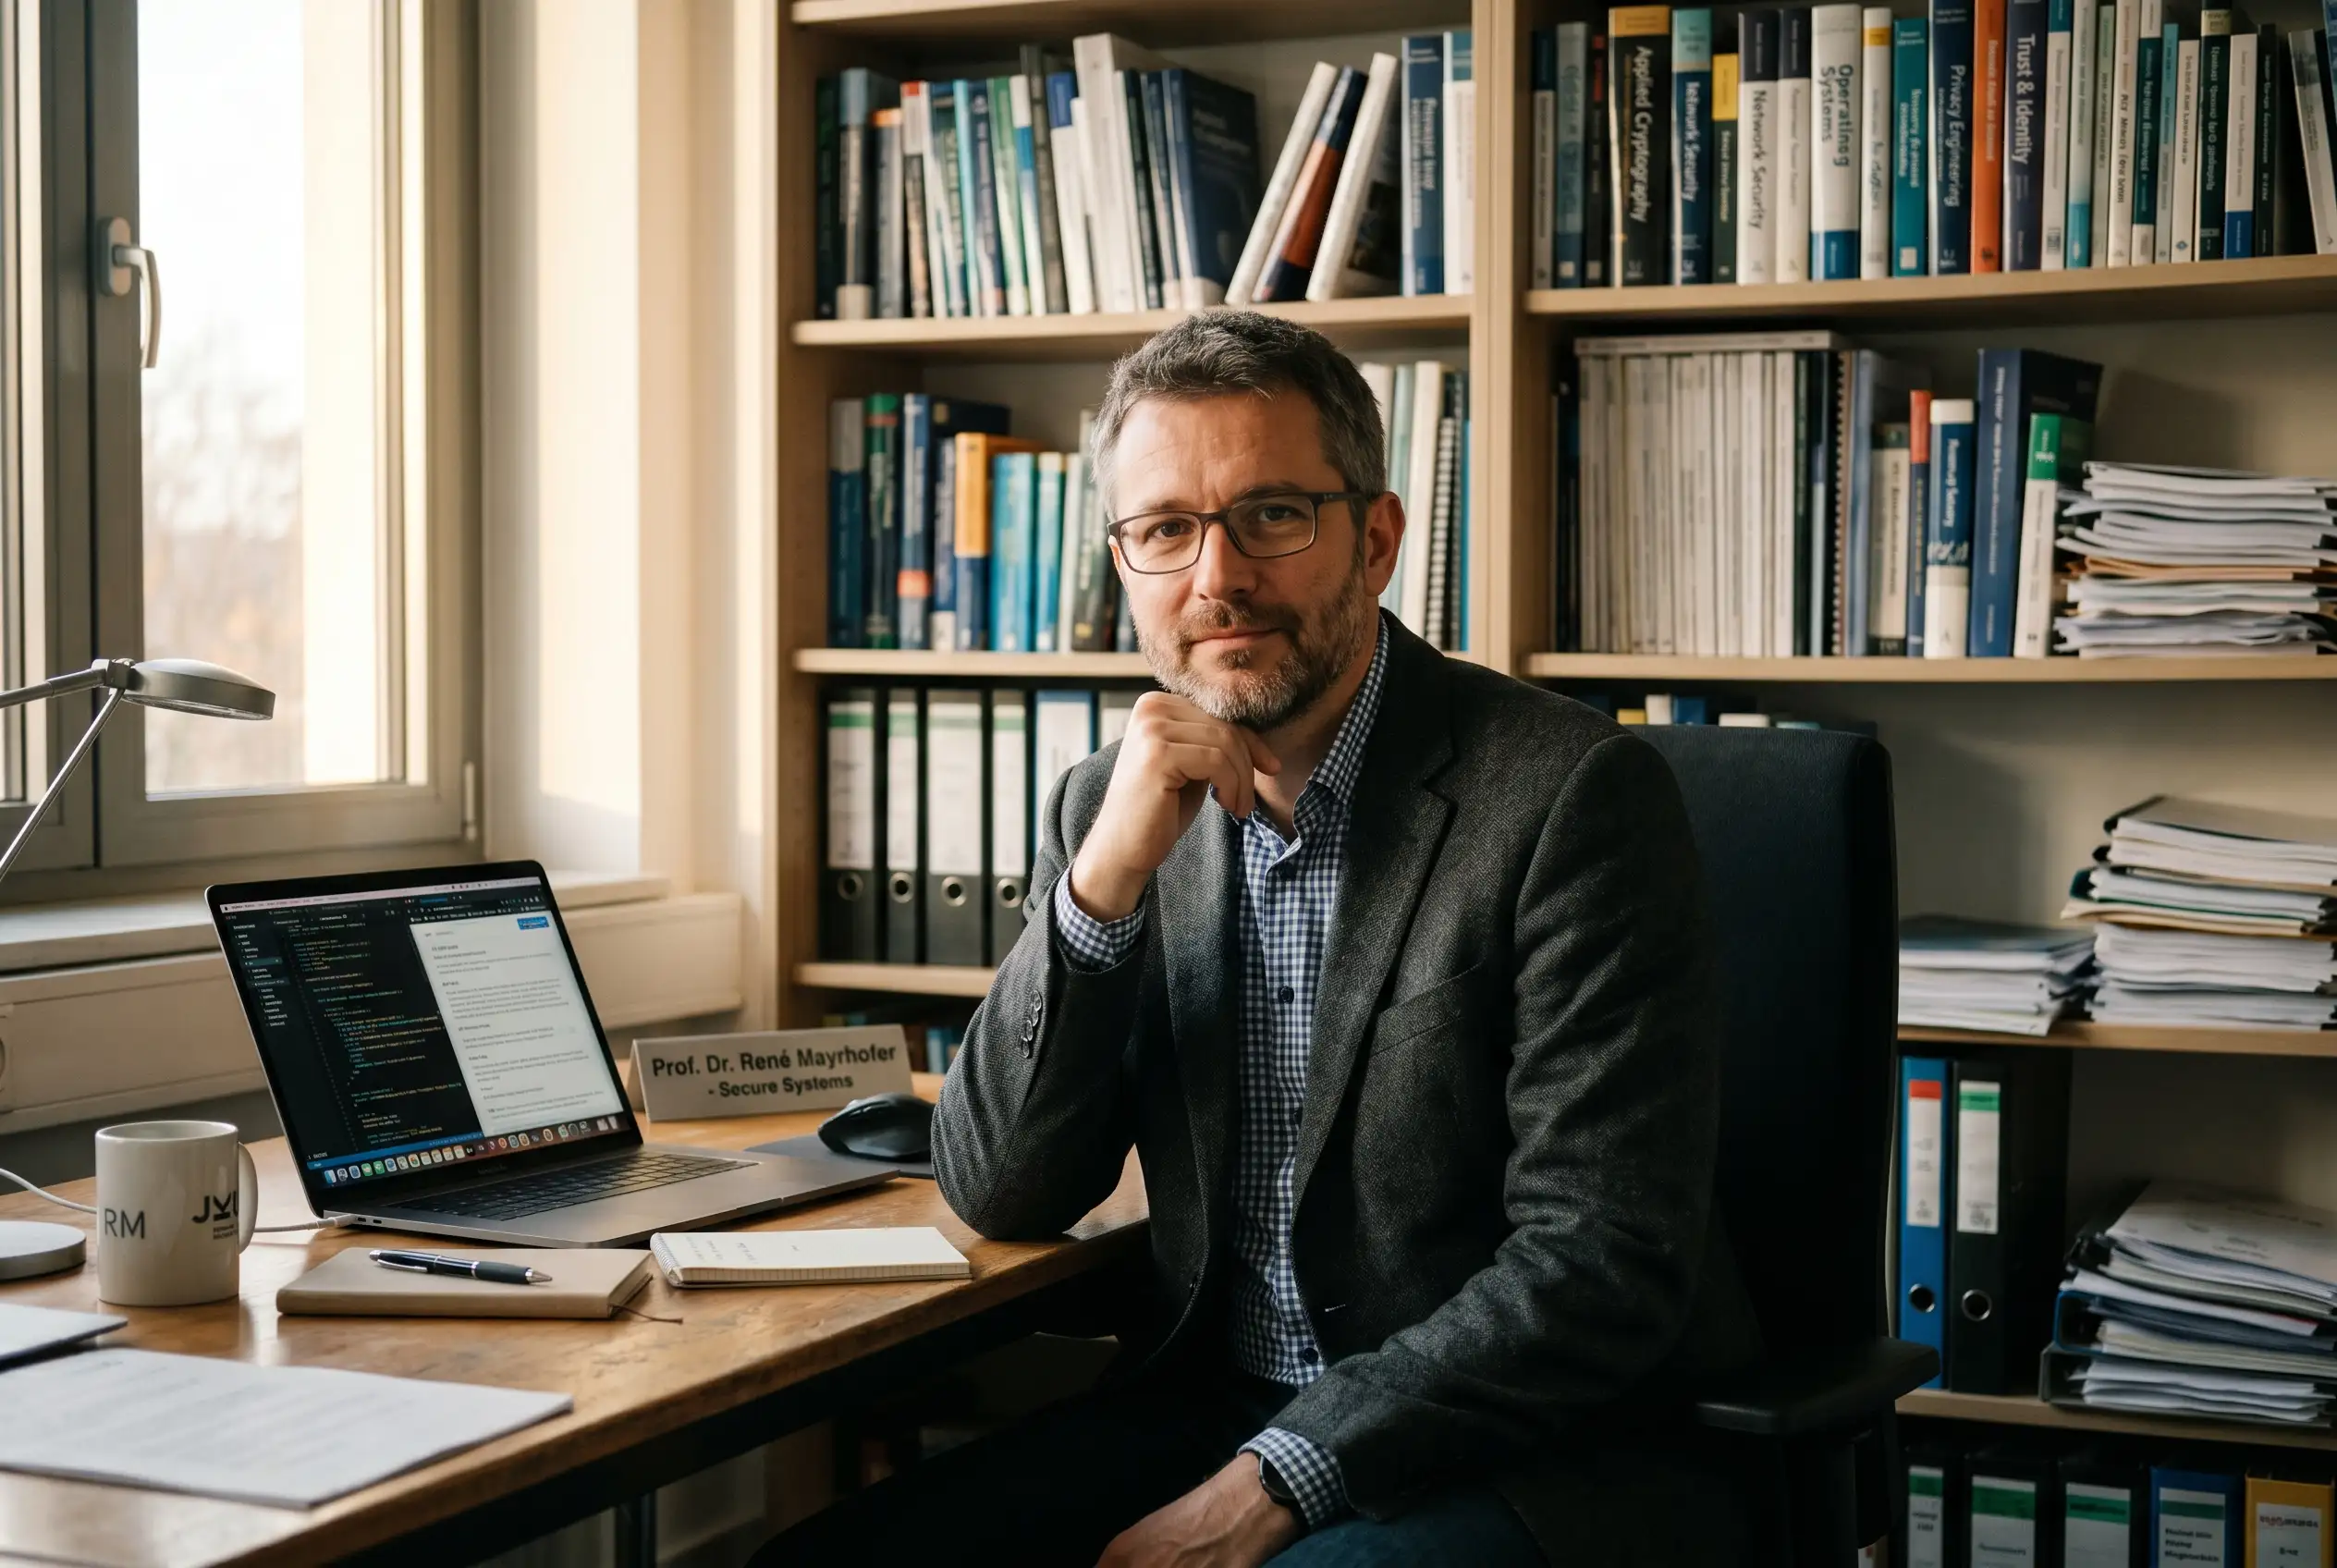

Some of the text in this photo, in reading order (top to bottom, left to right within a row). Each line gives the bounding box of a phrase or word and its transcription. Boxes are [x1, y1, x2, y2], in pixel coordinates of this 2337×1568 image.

[1629, 45, 1654, 223] Applied Cryptography
[1817, 66, 1836, 143] Systems
[1943, 64, 1966, 207] Privacy Engineering
[2011, 33, 2036, 165] Trust & Identity
[1747, 90, 1768, 230] Network Security
[651, 1043, 897, 1077] Prof. Dr. René Mayrhofer
[718, 1078, 778, 1098] Secure
[781, 1073, 854, 1096] Systems
[104, 1207, 146, 1240] RM
